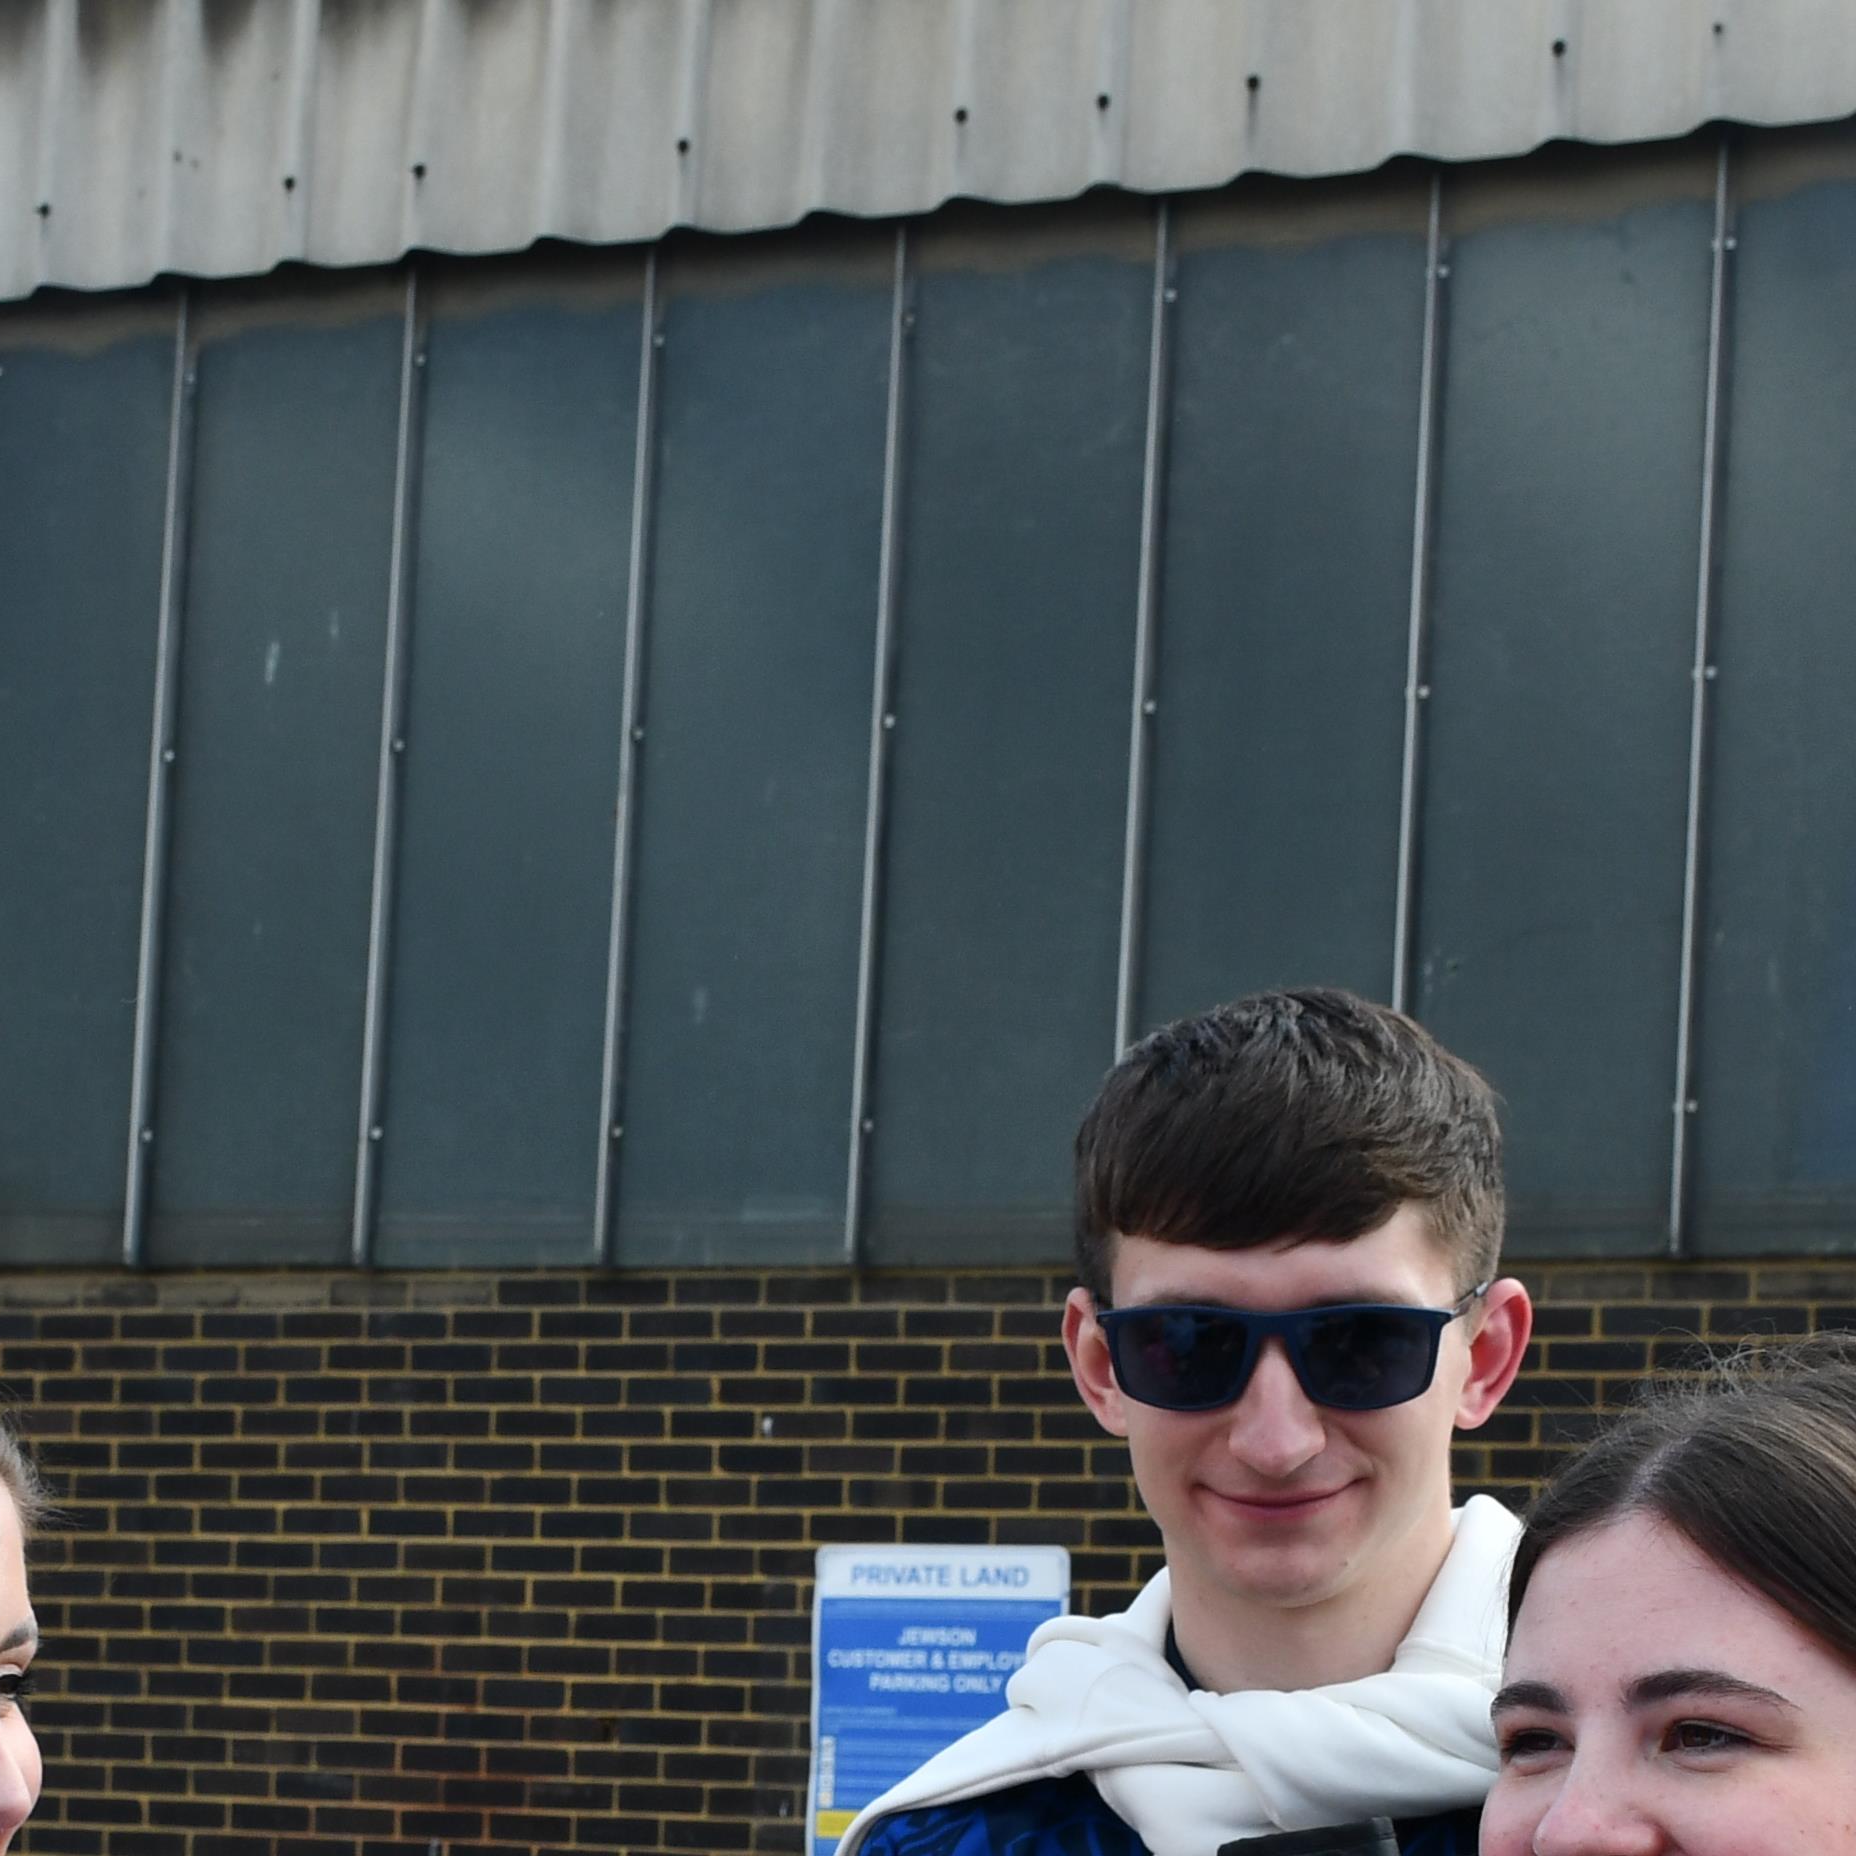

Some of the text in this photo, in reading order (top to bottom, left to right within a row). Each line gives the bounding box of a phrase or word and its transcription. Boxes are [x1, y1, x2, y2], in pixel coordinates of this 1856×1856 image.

[850, 1563, 1029, 1588] PRIVATE LAND
[898, 1626, 977, 1647] JEWSON
[827, 1648, 927, 1669] CUSTOMER
[930, 1650, 945, 1670] &
[868, 1672, 1003, 1694] PARKING ONLY
